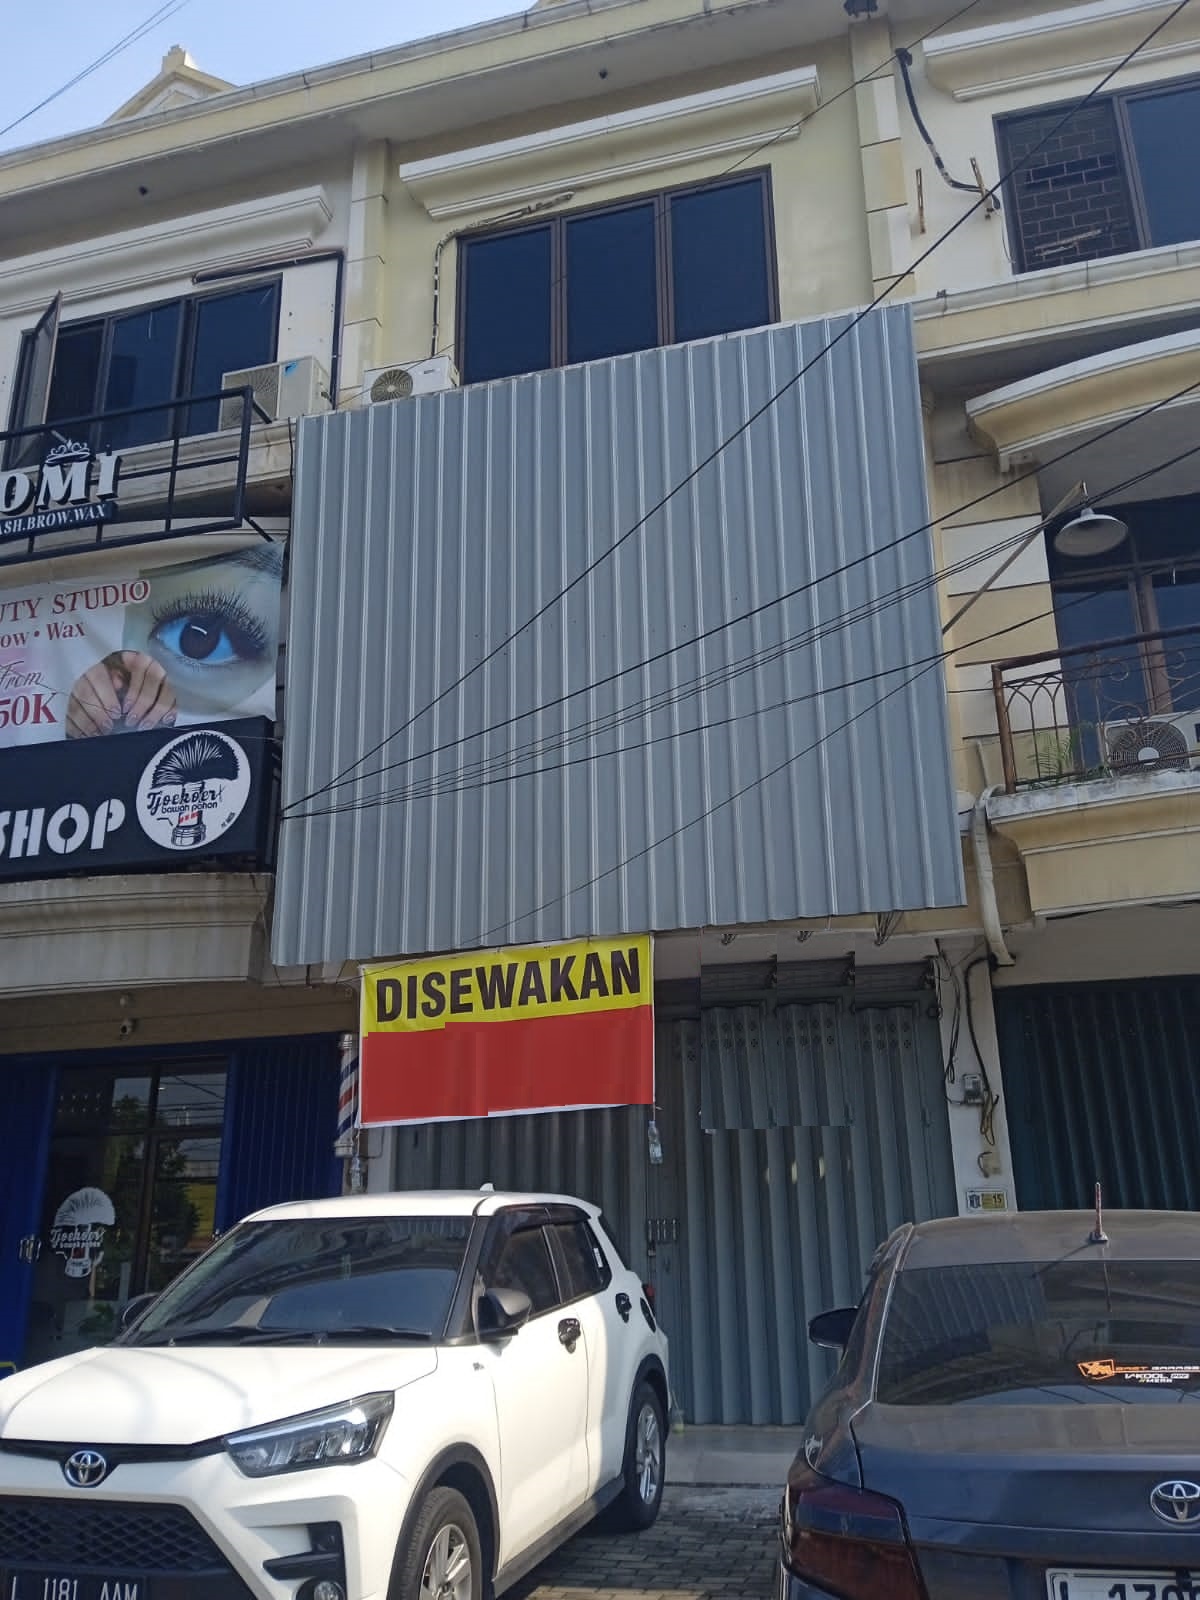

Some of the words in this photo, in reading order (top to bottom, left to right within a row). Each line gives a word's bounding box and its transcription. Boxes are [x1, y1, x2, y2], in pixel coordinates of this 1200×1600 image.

[52, 580, 149, 614] STUDIO
[46, 621, 86, 641] Wax
[376, 947, 641, 1023] DISEWAKAN
[44, 1577, 79, 1600] 1181
[100, 1581, 138, 1600] AAM
